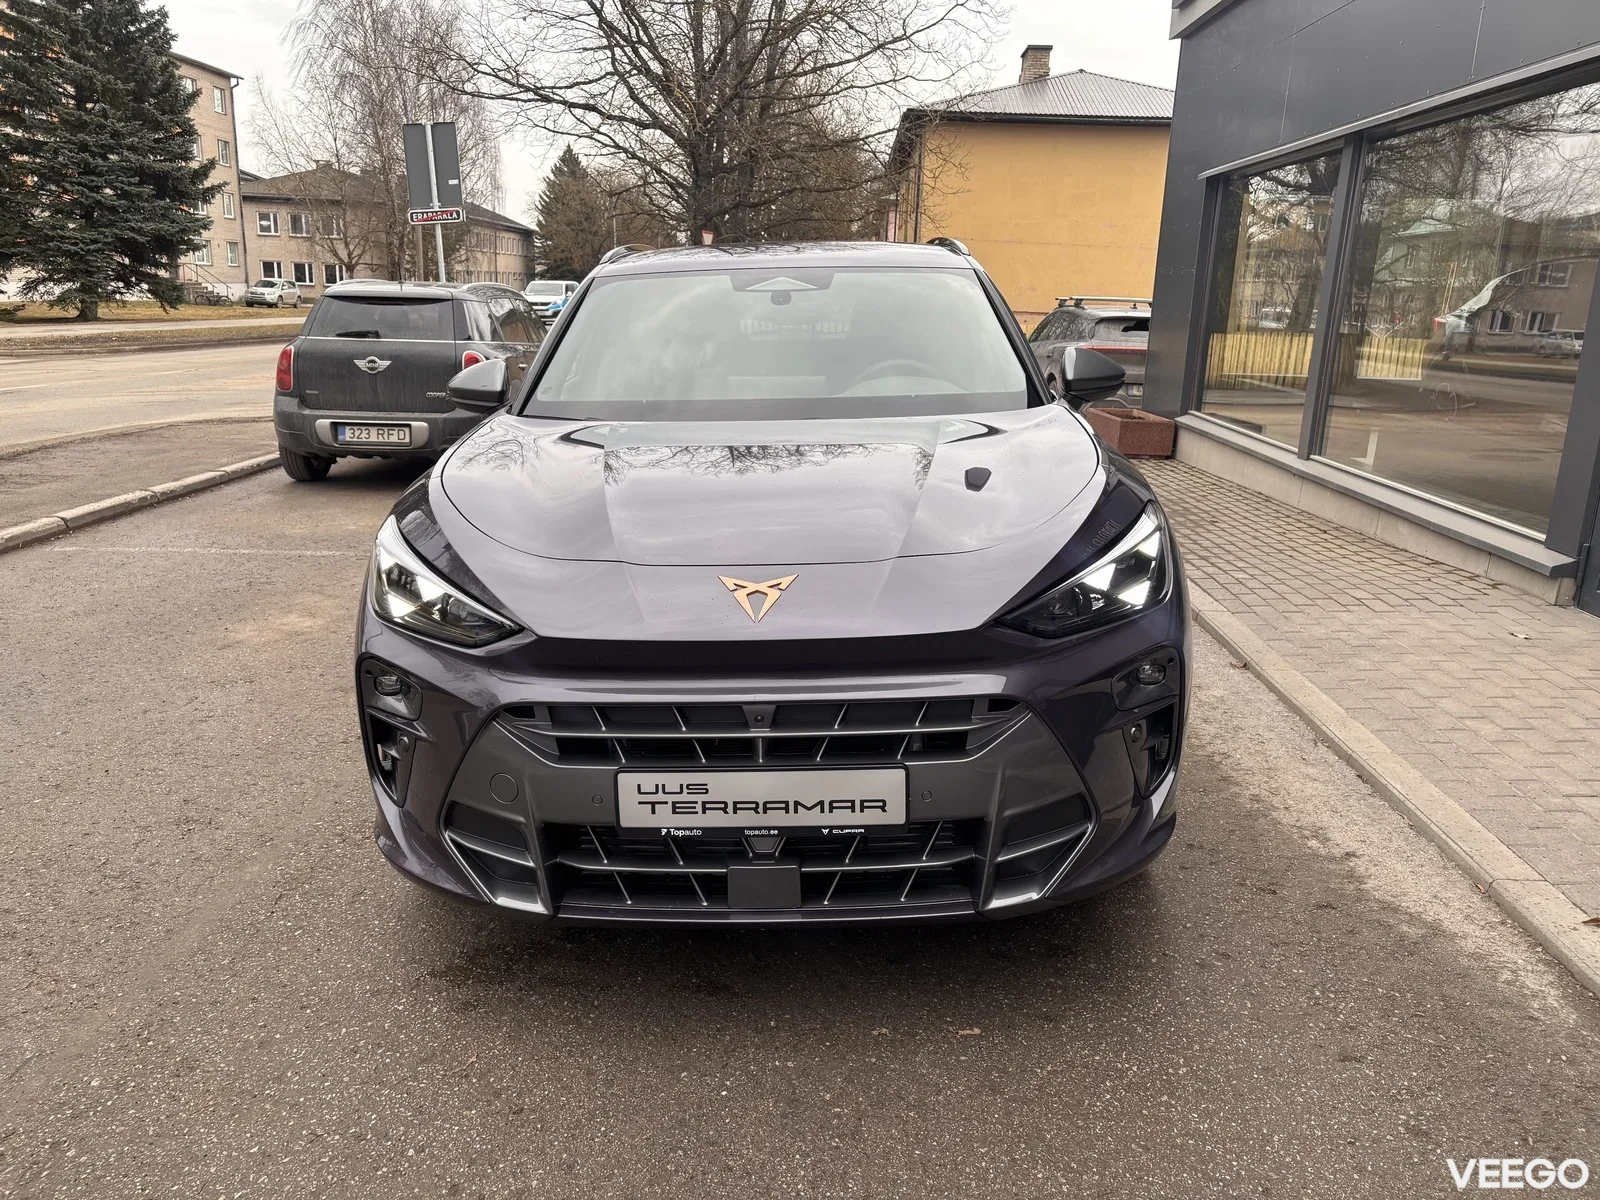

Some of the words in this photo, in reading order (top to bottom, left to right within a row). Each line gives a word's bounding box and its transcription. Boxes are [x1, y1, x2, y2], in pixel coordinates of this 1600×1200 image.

[348, 427, 371, 440] 323
[376, 428, 406, 441] RFD
[637, 783, 709, 795] UUS
[637, 798, 888, 815] TERRAMAR
[669, 828, 702, 837] Topauto
[744, 828, 779, 836] topauto.ee
